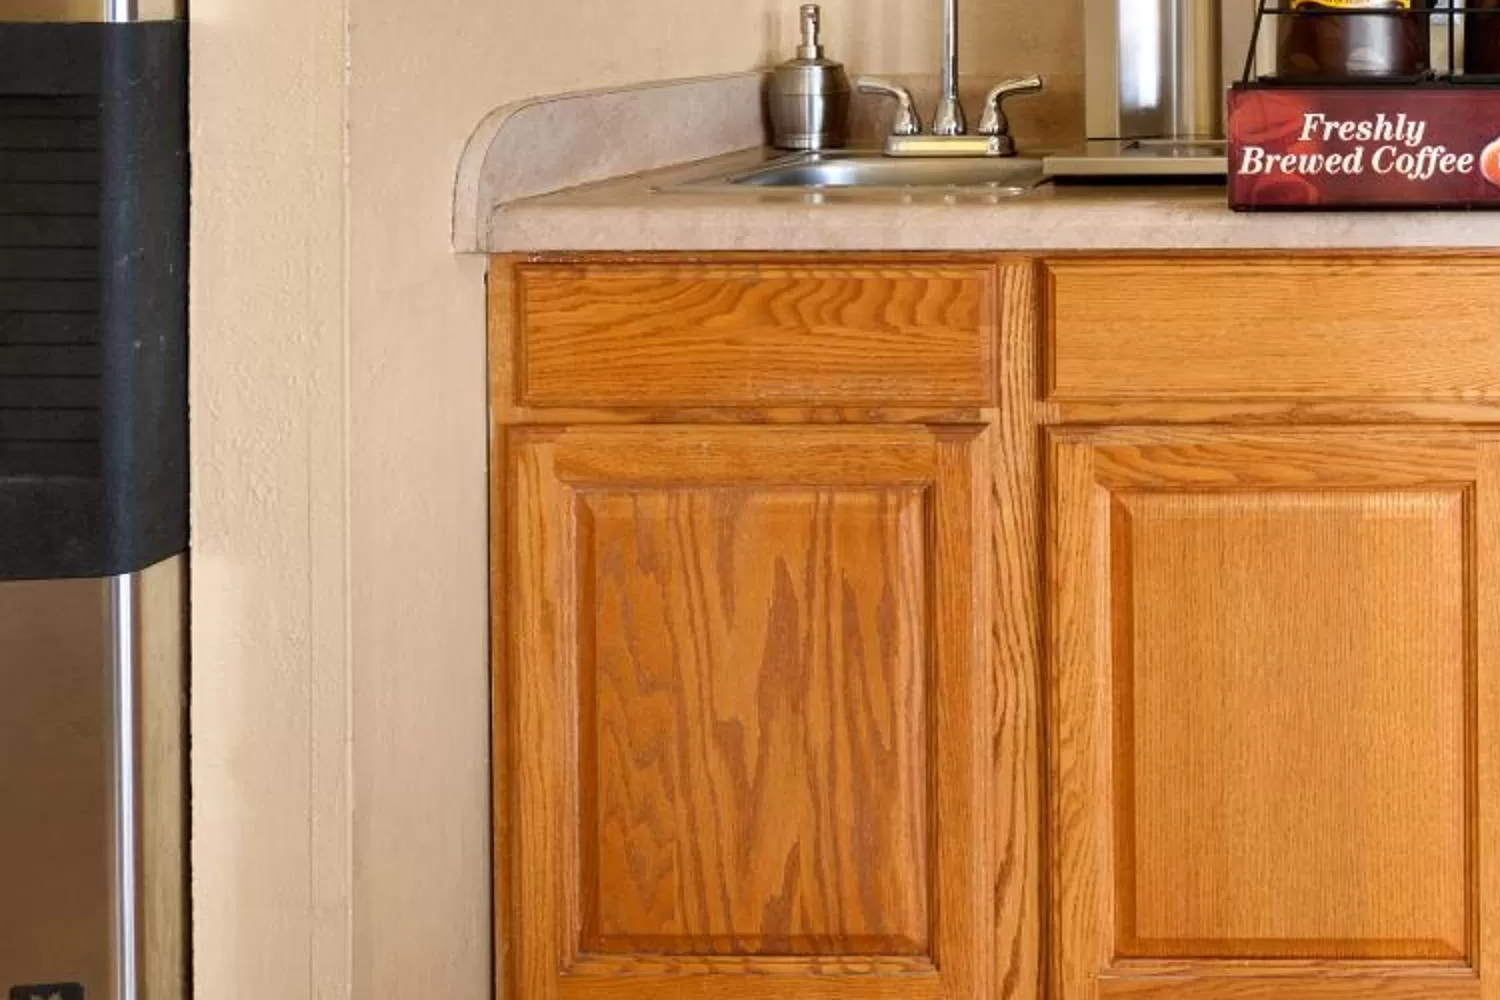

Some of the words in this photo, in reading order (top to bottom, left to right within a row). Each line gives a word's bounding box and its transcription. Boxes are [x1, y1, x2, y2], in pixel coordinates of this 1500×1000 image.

[1298, 112, 1427, 147] Freshly
[1238, 145, 1364, 175] Brewed
[1371, 145, 1475, 180] Coffee
